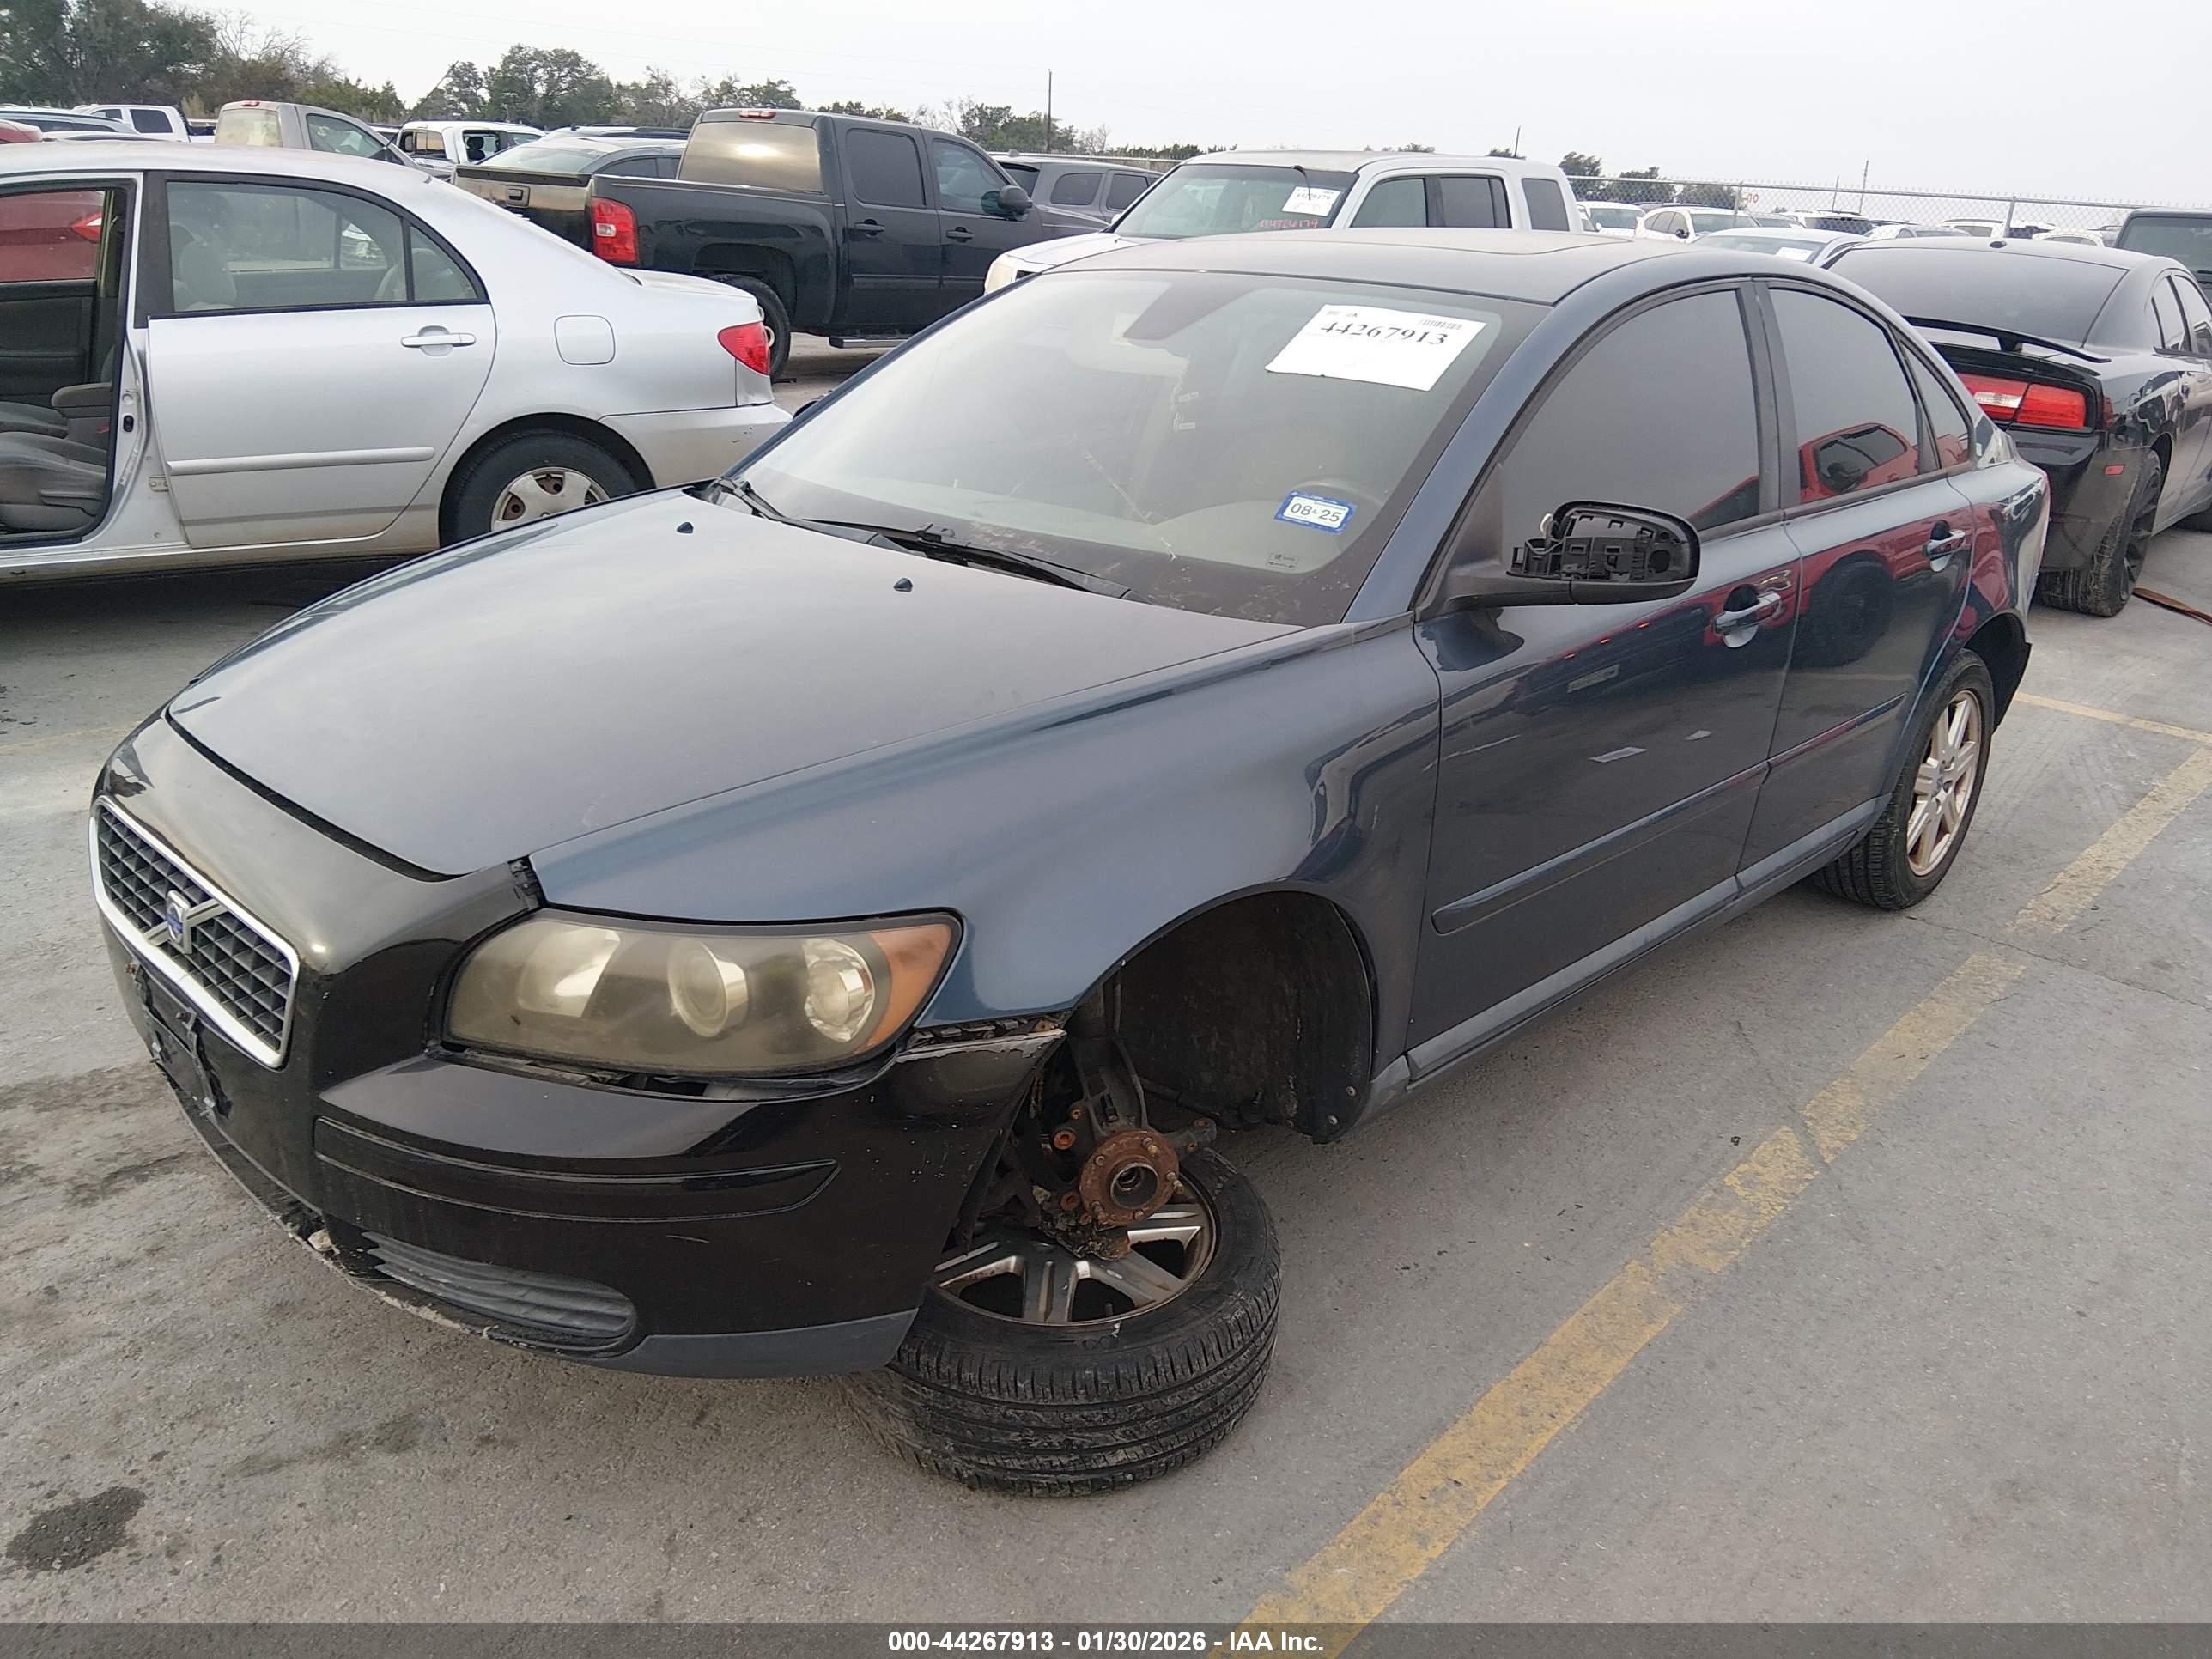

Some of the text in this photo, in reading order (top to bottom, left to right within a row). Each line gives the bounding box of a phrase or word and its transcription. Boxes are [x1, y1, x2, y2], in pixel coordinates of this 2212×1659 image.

[1320, 321, 1449, 345] 44267913
[1291, 502, 1313, 516] 08
[1318, 509, 1342, 523] 25
